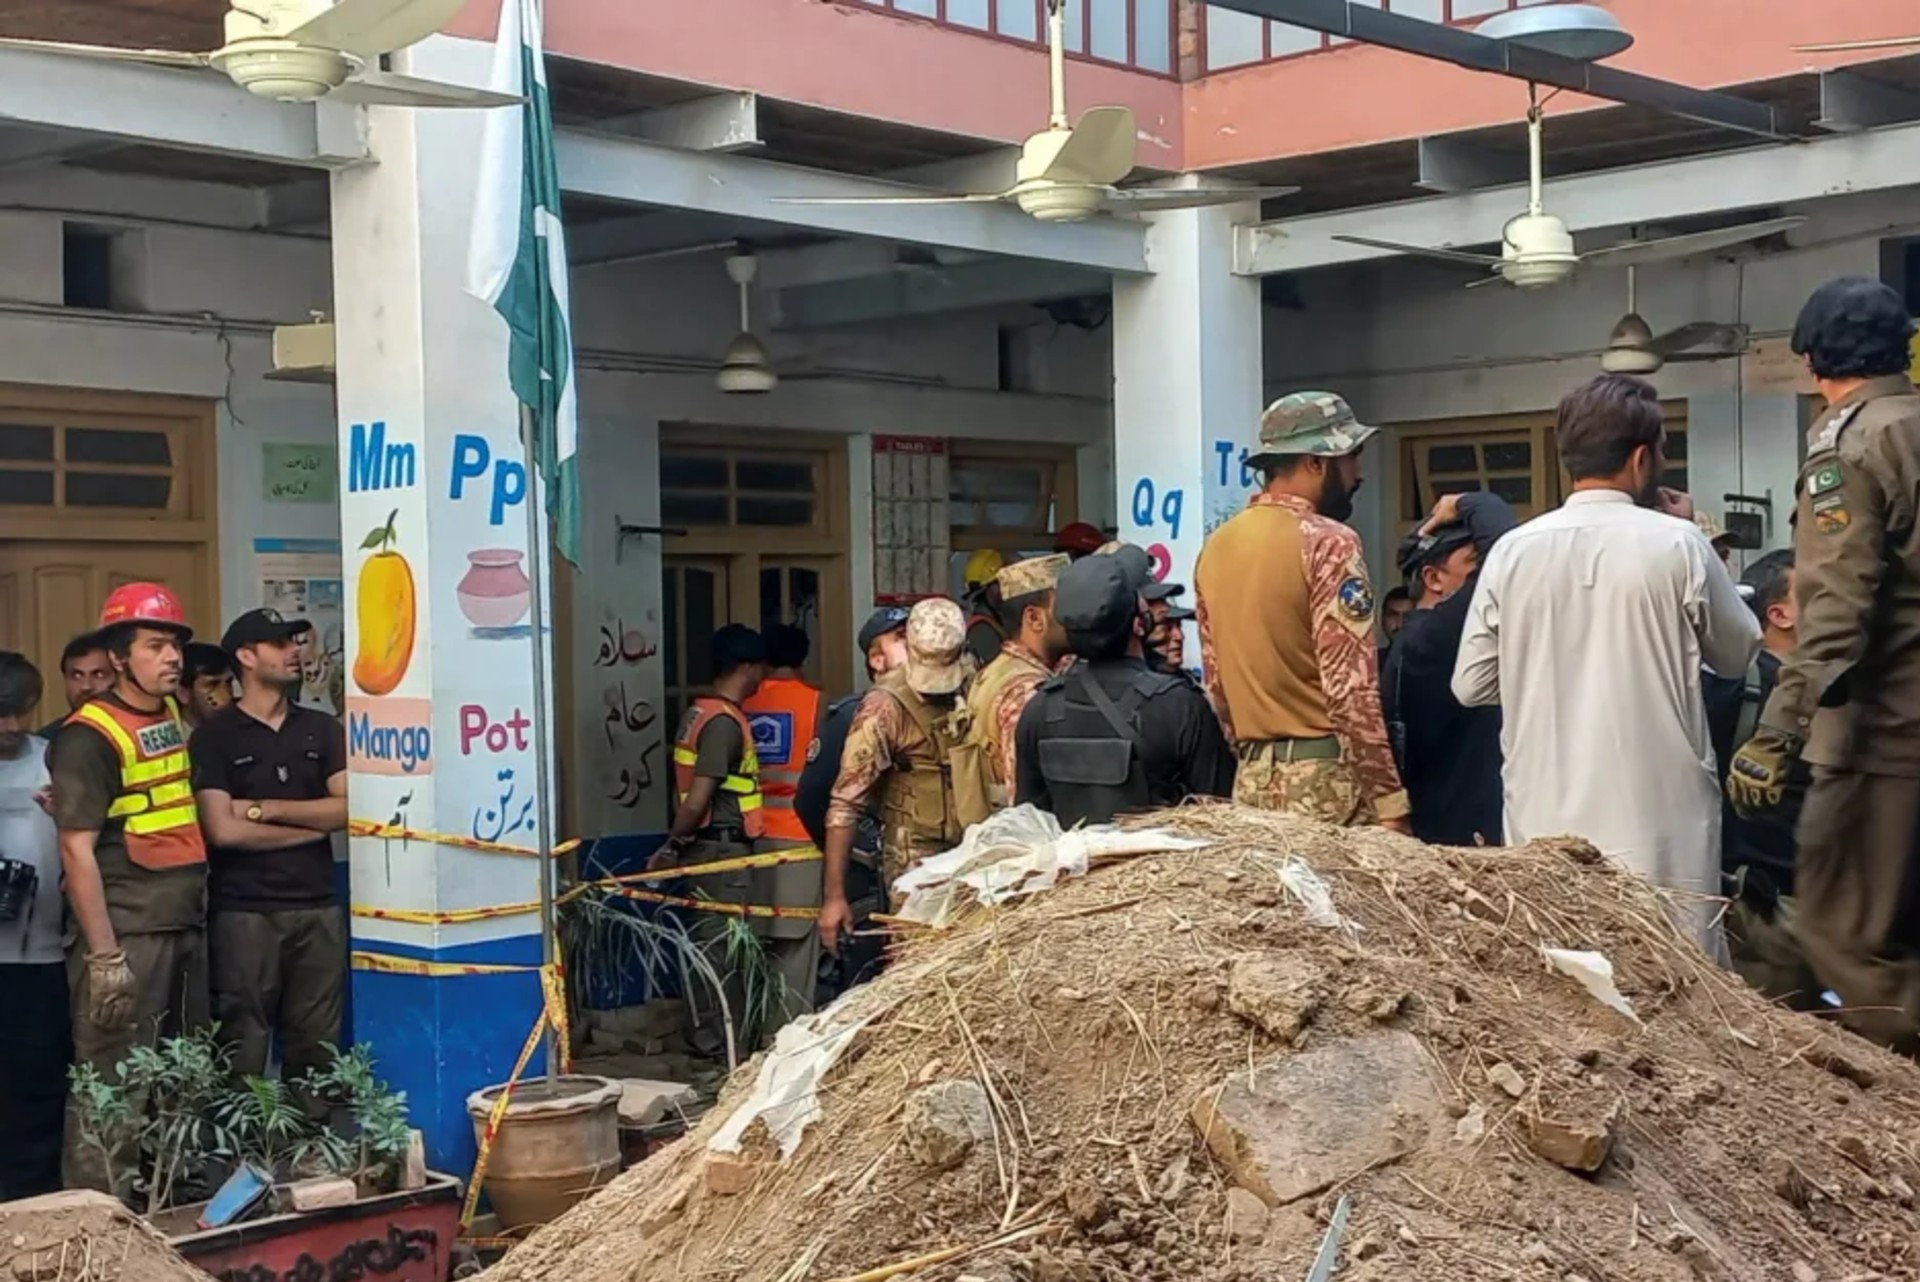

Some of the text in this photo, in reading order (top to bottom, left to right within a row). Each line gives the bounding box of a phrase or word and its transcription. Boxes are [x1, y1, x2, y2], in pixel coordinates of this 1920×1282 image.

[348, 421, 416, 493] Mm
[448, 433, 526, 525] Pp
[1132, 476, 1184, 541] Qq
[593, 617, 658, 668] سلام
[348, 711, 431, 773] Mango
[458, 703, 531, 756] Pot
[603, 681, 657, 753] عام
[472, 768, 536, 844] برتن
[606, 739, 661, 809] کرو
